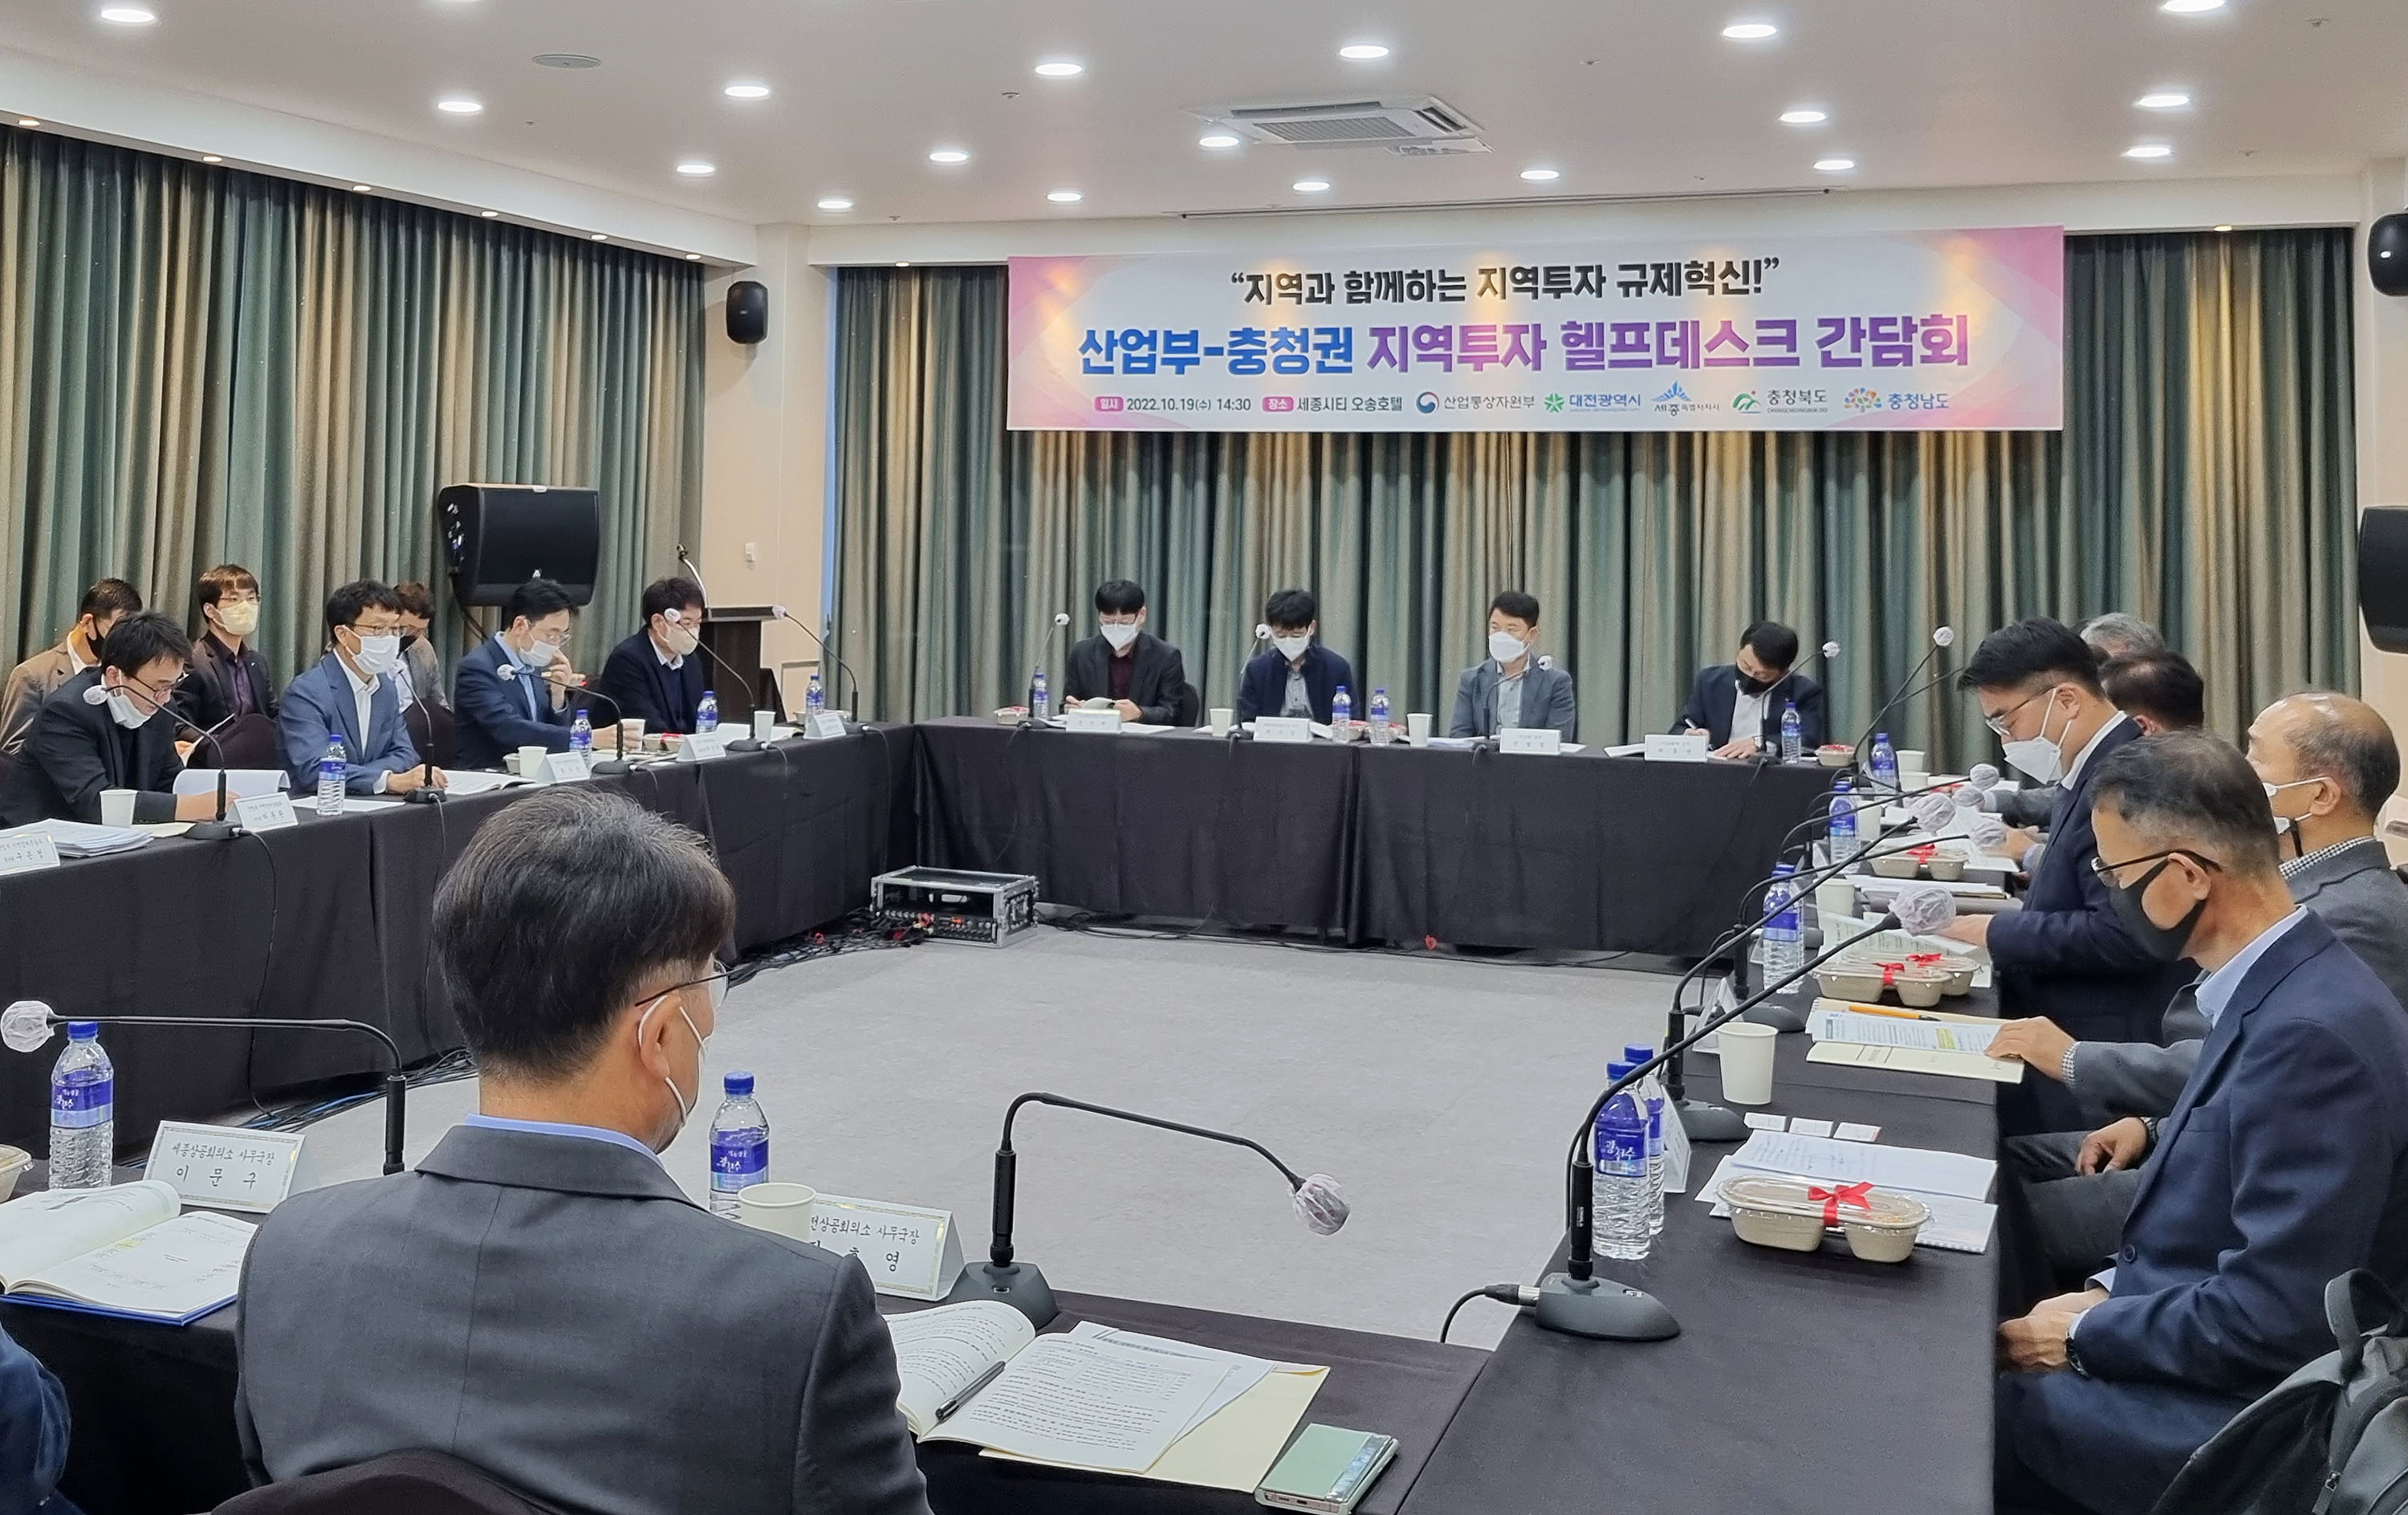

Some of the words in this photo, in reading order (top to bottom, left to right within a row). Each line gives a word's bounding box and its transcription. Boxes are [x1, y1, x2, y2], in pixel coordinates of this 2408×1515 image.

[1230, 271, 1335, 305] “지역과
[1344, 269, 1466, 304] 함께하는
[1478, 265, 1606, 300] 지역투자
[1617, 257, 1780, 299] 규제혁신!”
[1079, 326, 1353, 376] 산업부-충청권
[1367, 322, 1547, 373] 지역투자
[1560, 319, 1800, 371] 헬프데스크
[1816, 314, 1969, 368] 간담회
[1100, 398, 1118, 409] 일시
[1126, 397, 1212, 412] 2022.10.19(수)
[1217, 398, 1251, 411] 14:30
[1267, 398, 1288, 410] 장소
[1296, 397, 1348, 413] 세종시티
[1352, 396, 1403, 412] 오송호텔
[1444, 395, 1536, 410] 산업통상자원부
[1569, 393, 1641, 408] 대전광역시
[1767, 389, 1828, 406] 충청북도
[1888, 392, 1949, 410] 충청남도
[172, 1142, 234, 1160] 세종상공회의소
[239, 1149, 275, 1166] 사무국장
[877, 1224, 921, 1244] 사무국장
